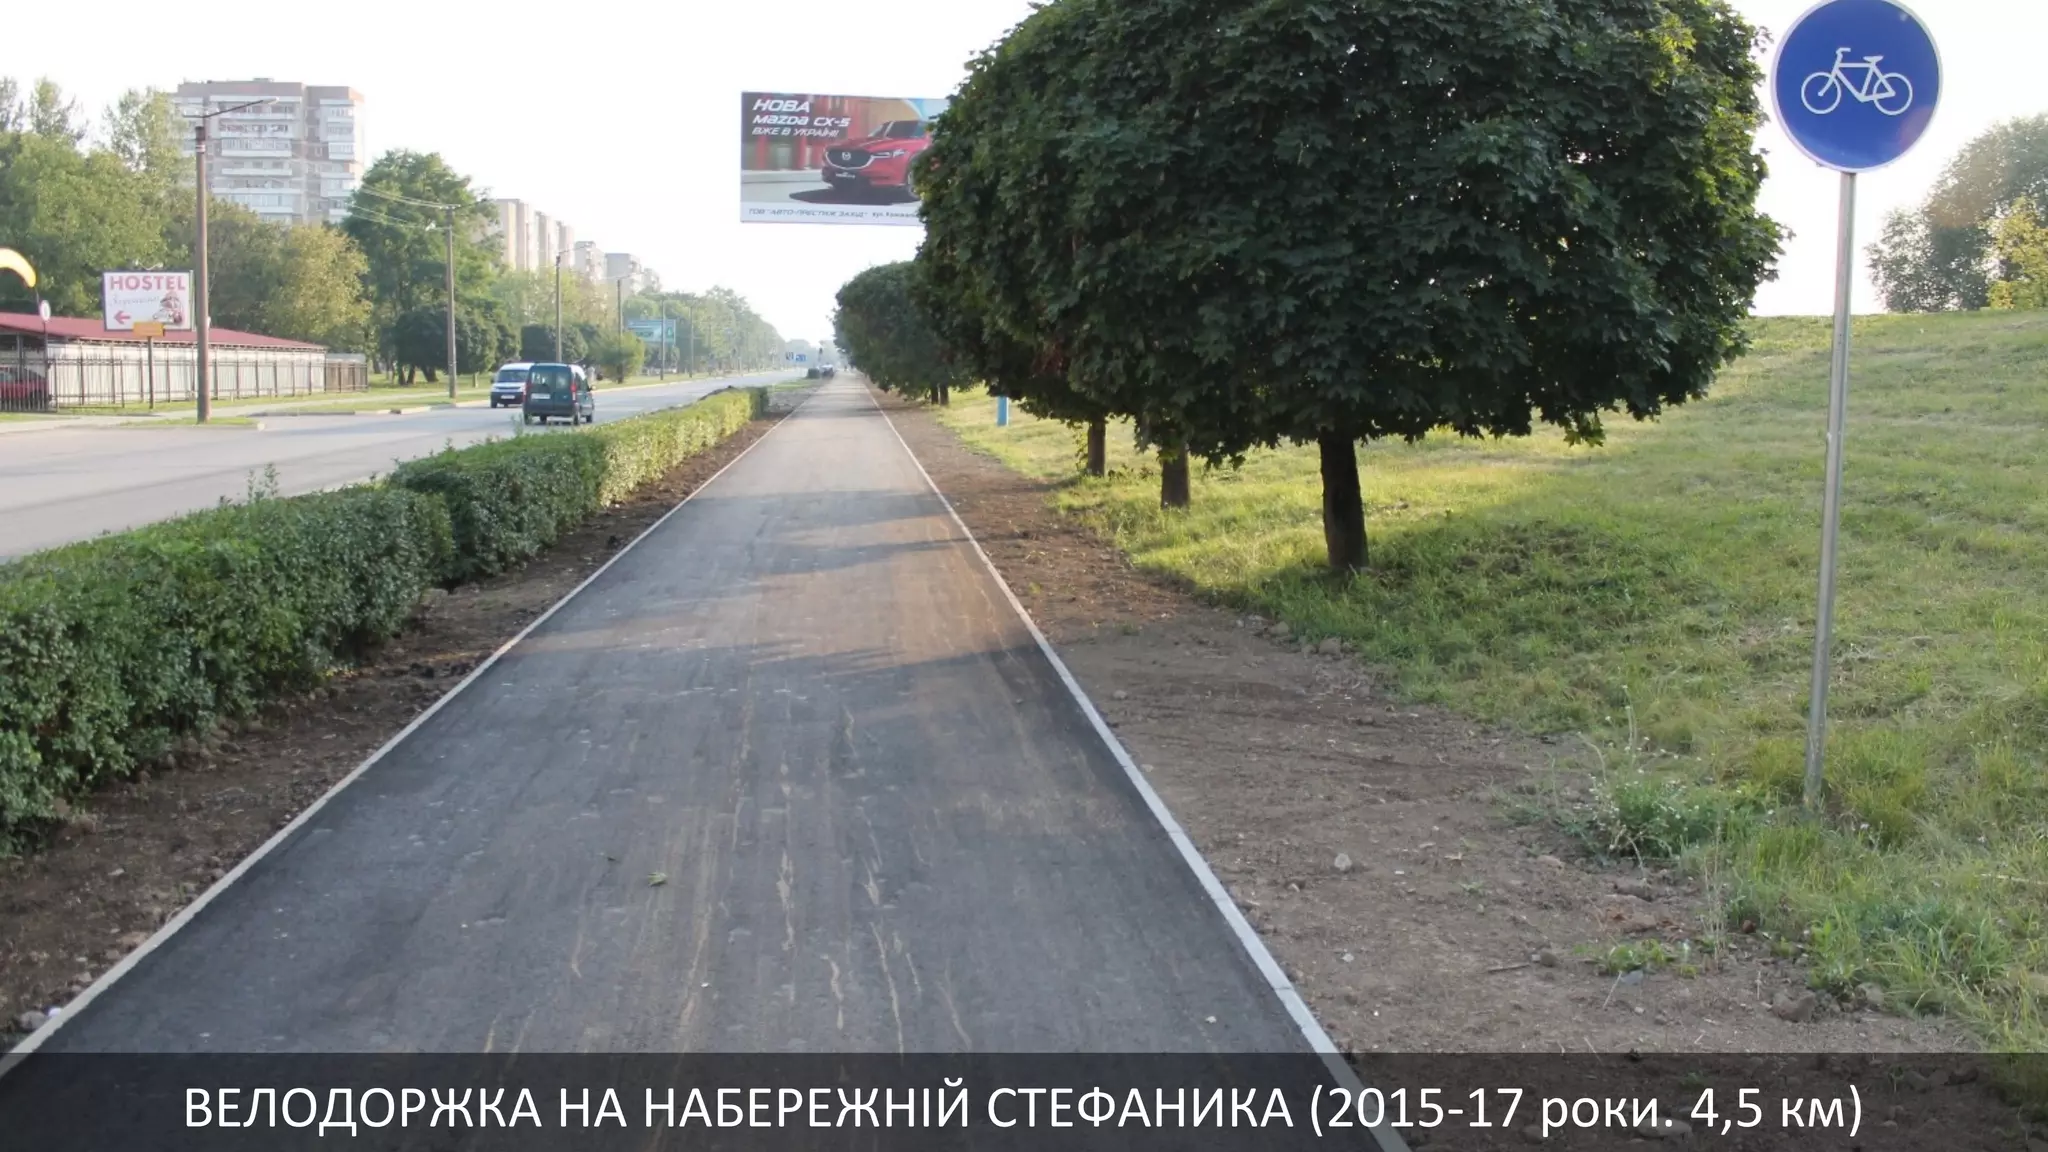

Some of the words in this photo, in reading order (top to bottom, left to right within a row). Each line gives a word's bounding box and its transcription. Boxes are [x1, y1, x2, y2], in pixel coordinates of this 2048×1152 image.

[752, 98, 810, 113] НОВА
[813, 117, 851, 127] CX-5
[752, 127, 780, 136] ВЖЕ
[781, 127, 792, 136] В
[110, 275, 186, 291] HOSTEL
